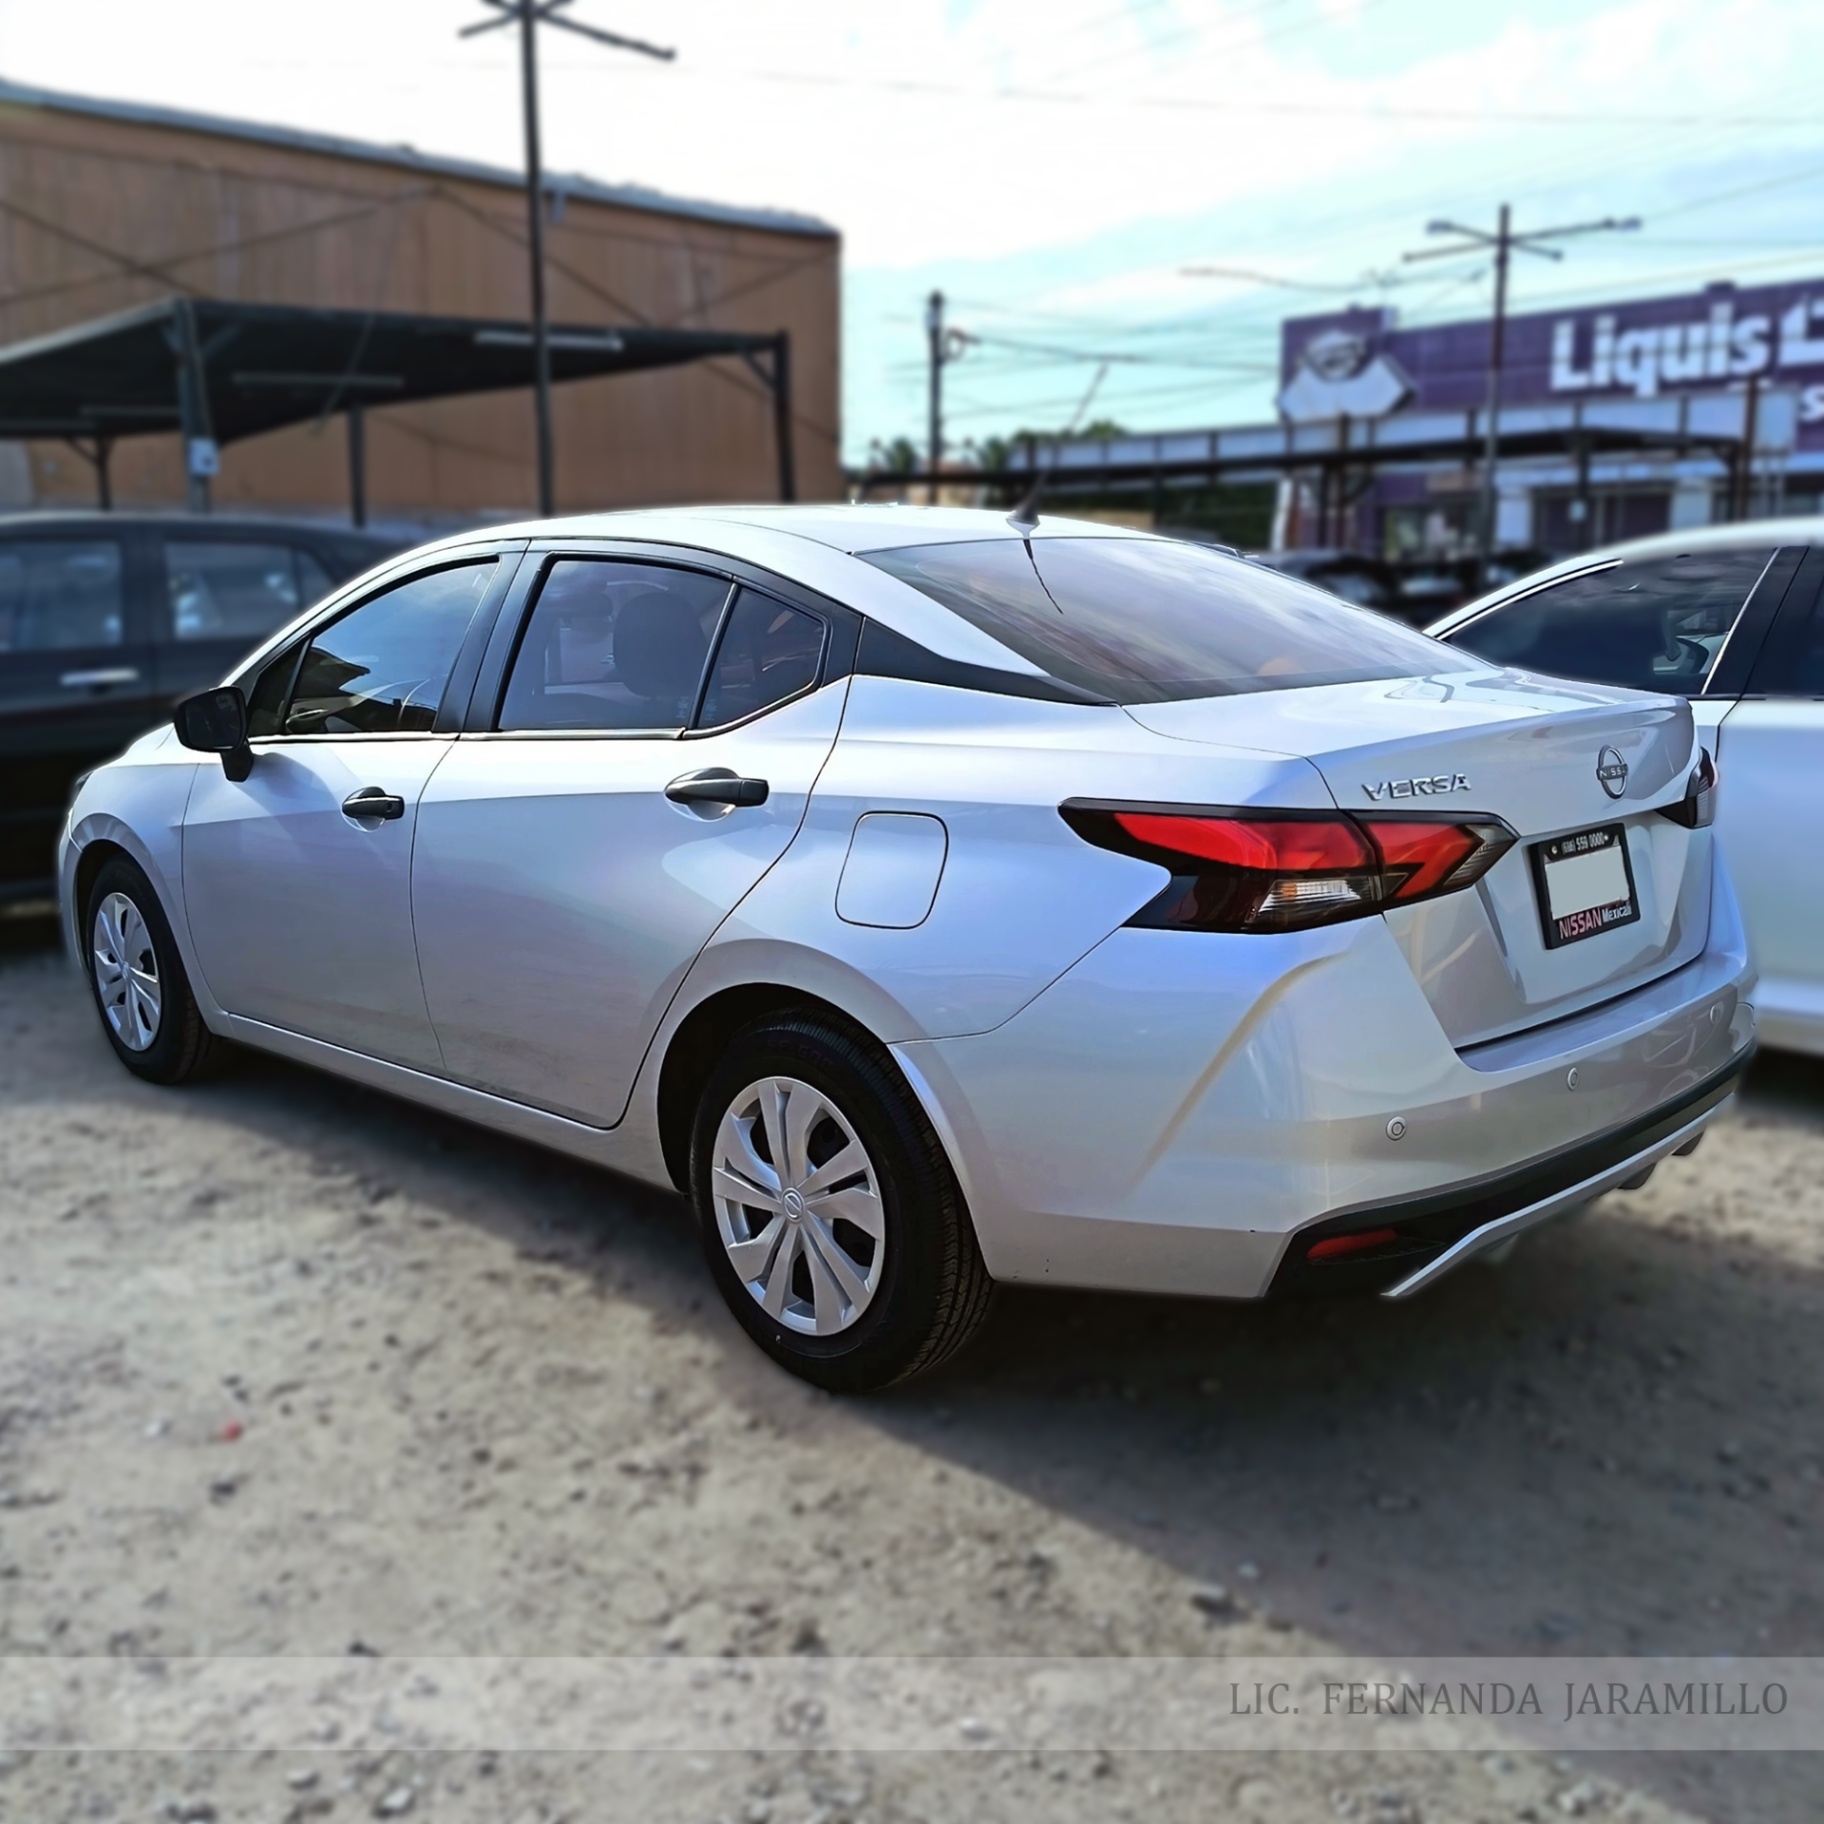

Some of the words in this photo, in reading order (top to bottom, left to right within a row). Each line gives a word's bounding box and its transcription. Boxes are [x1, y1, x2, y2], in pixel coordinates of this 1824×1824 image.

[1551, 302, 1769, 397] Liquis
[1361, 773, 1471, 801] VERSA
[1559, 908, 1602, 940] NISSAN
